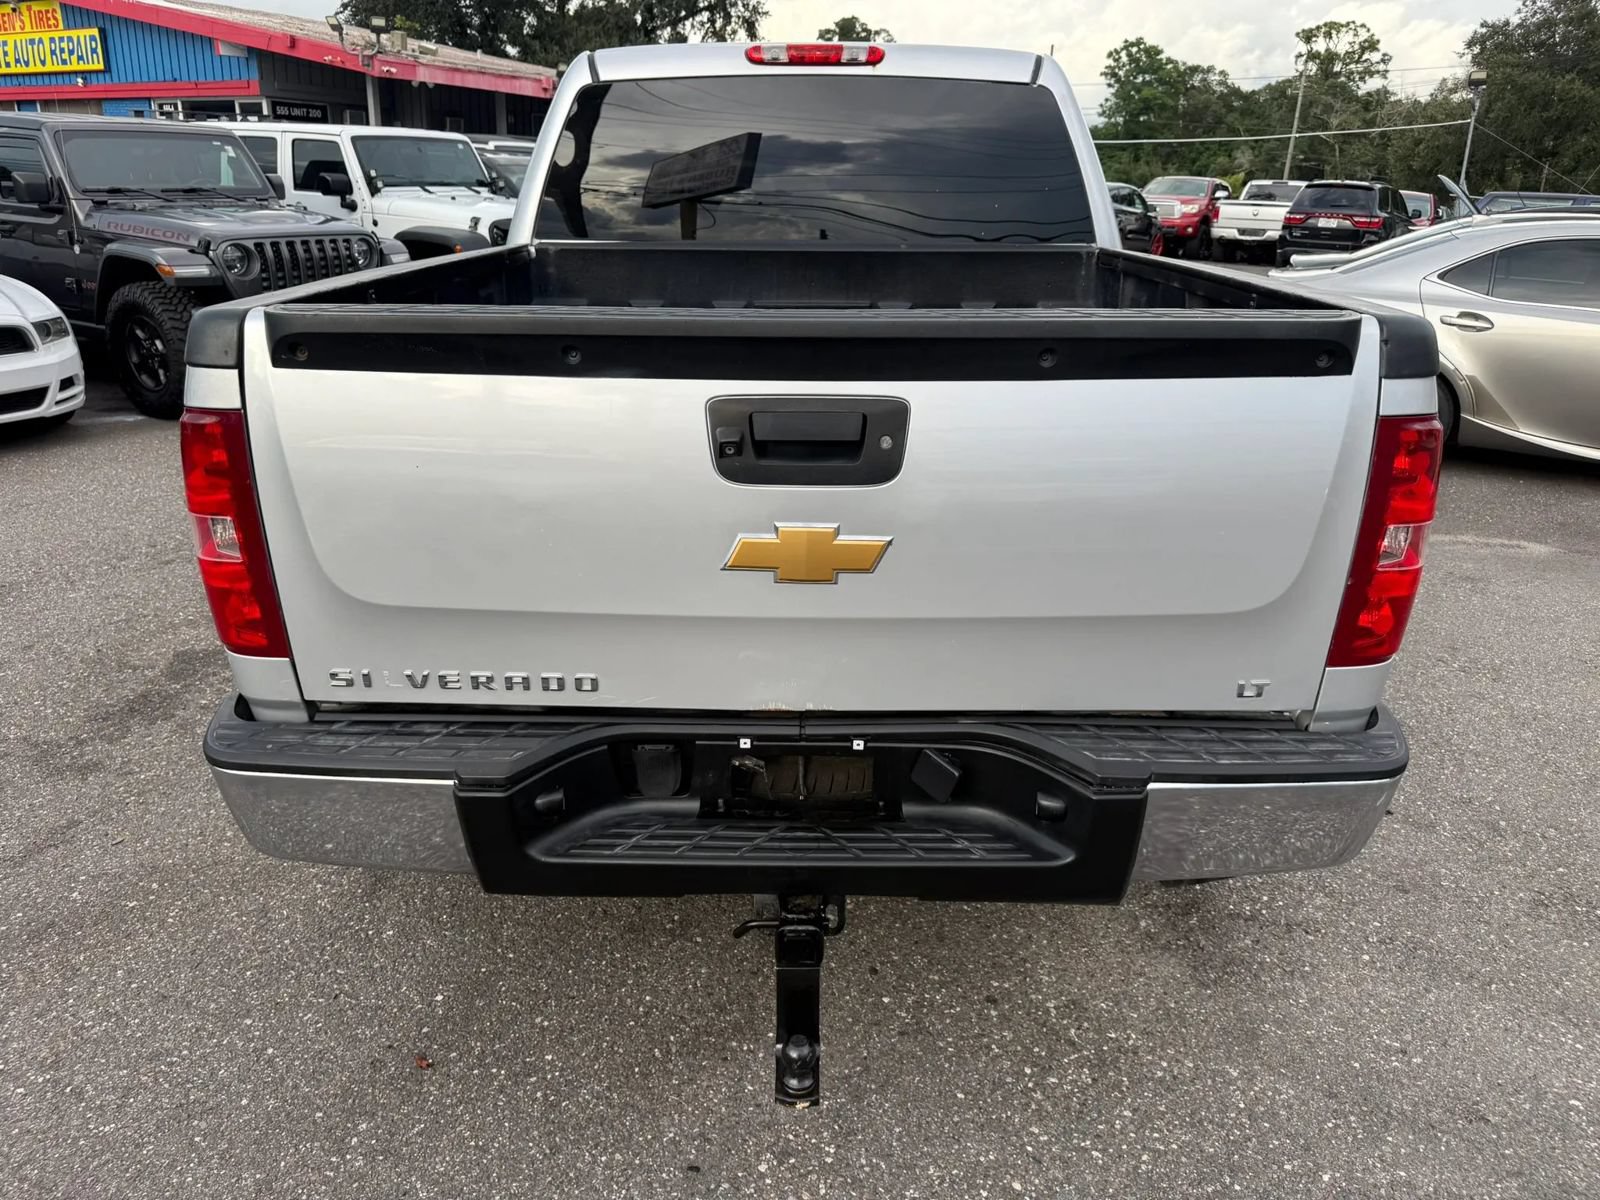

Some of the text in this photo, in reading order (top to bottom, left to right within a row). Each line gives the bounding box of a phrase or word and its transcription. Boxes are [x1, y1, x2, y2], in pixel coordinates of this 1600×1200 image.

[0, 5, 59, 31] EN'S TIRES
[14, 37, 46, 67] AUTO
[49, 34, 100, 66] REPAIR
[290, 107, 307, 117] UNIT
[106, 221, 190, 240] RUBICON
[329, 669, 599, 692] SILVERADO
[1237, 680, 1271, 698] LT
